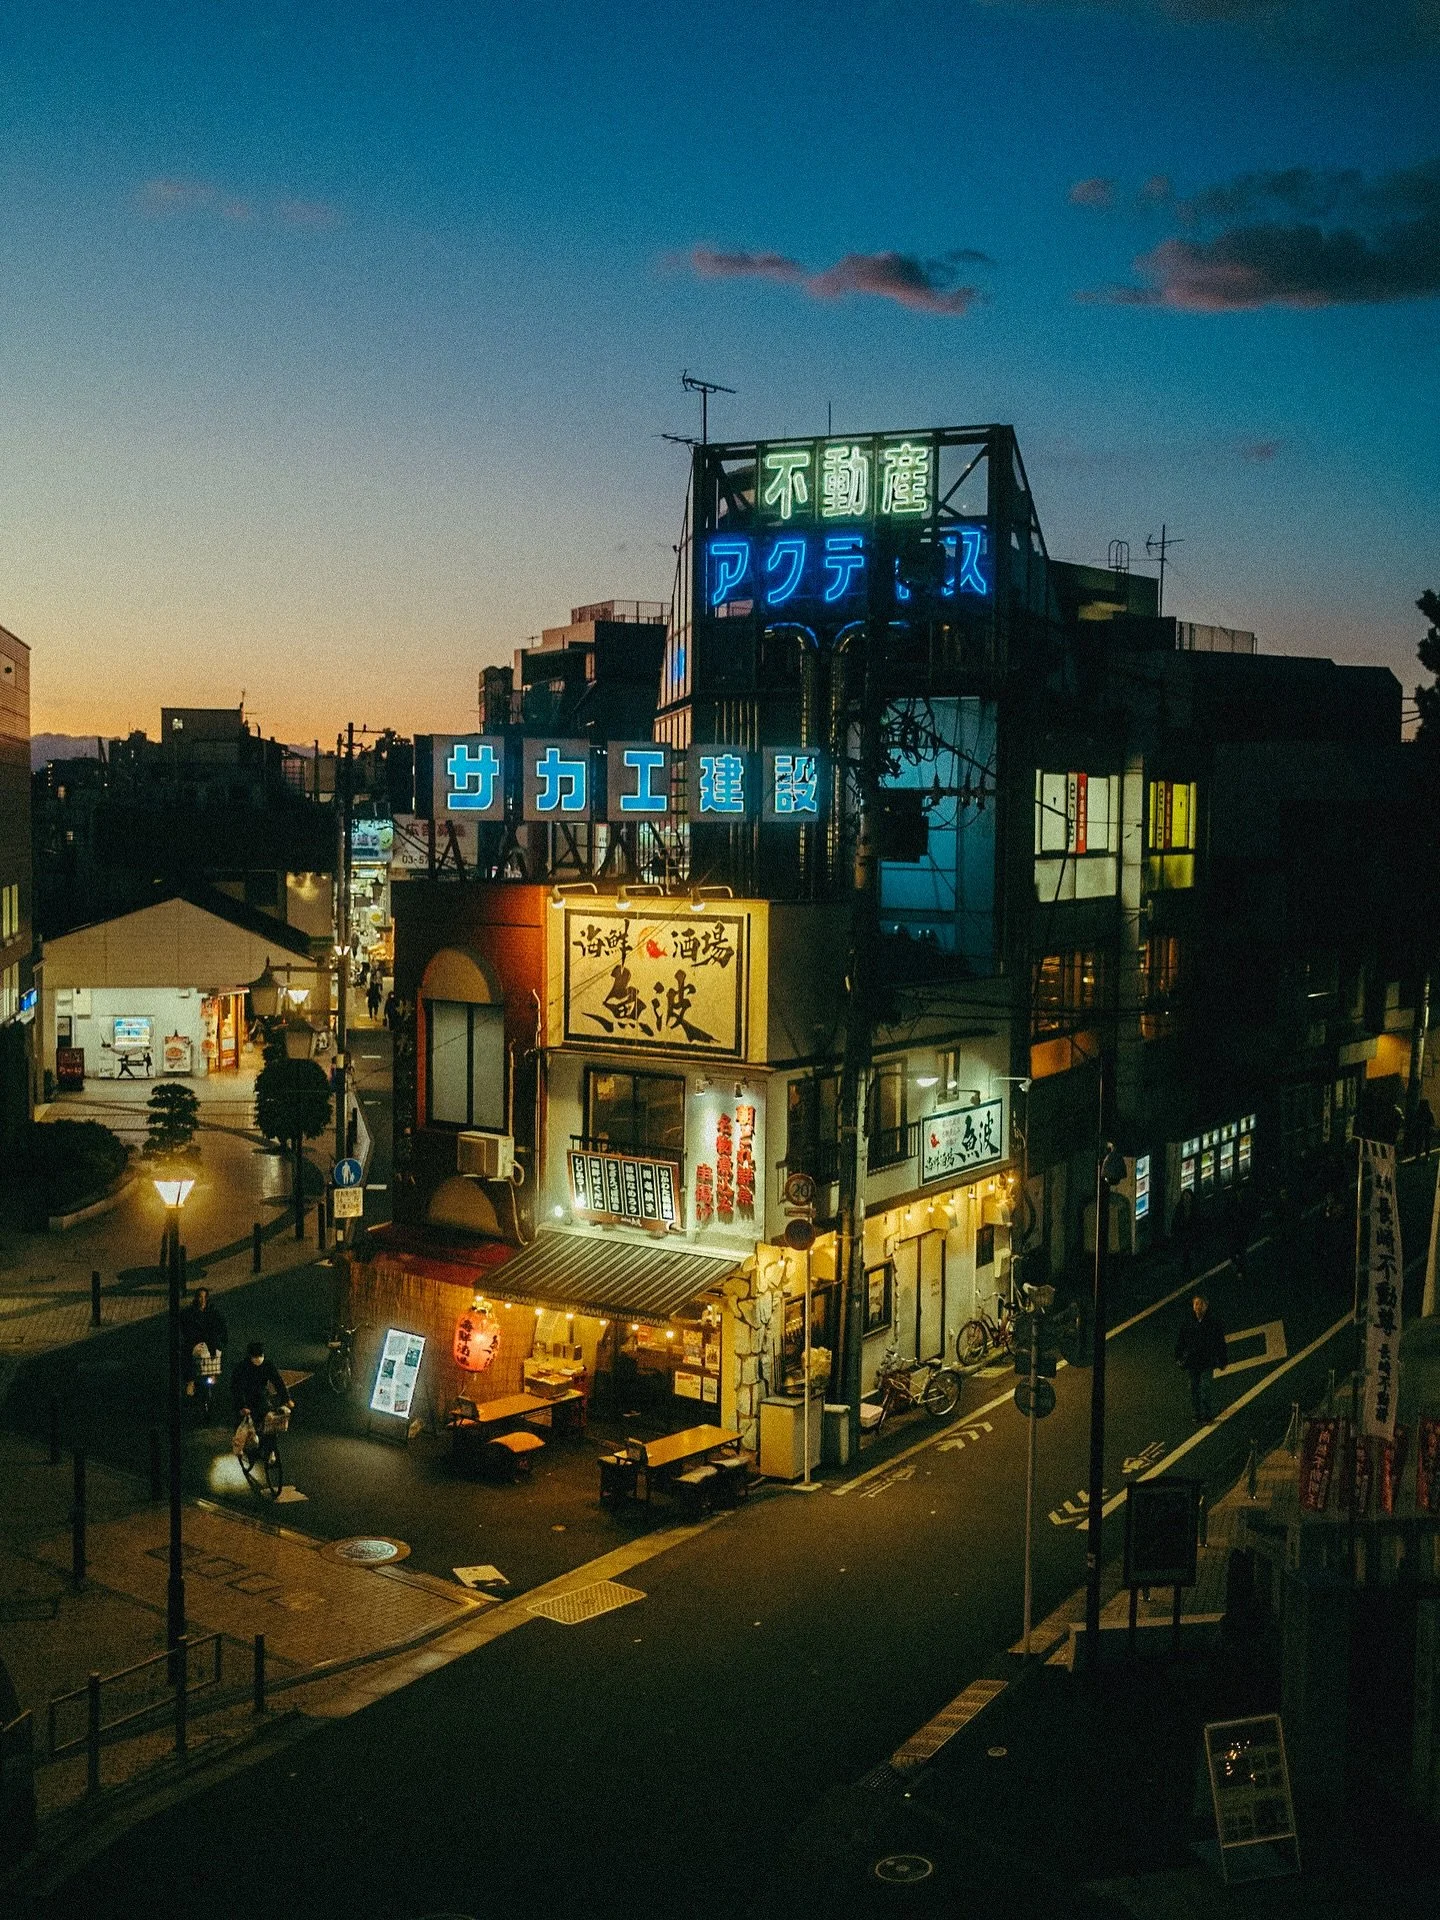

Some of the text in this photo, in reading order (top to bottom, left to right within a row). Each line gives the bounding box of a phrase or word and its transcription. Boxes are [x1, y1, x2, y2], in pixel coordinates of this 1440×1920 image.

[765, 443, 928, 520] 不動産
[711, 530, 988, 607] アクテス
[573, 918, 735, 968] 海鮮 酒場
[580, 964, 722, 1043] 魚波
[954, 1109, 1000, 1163] 魚波
[791, 1183, 809, 1198] 20
